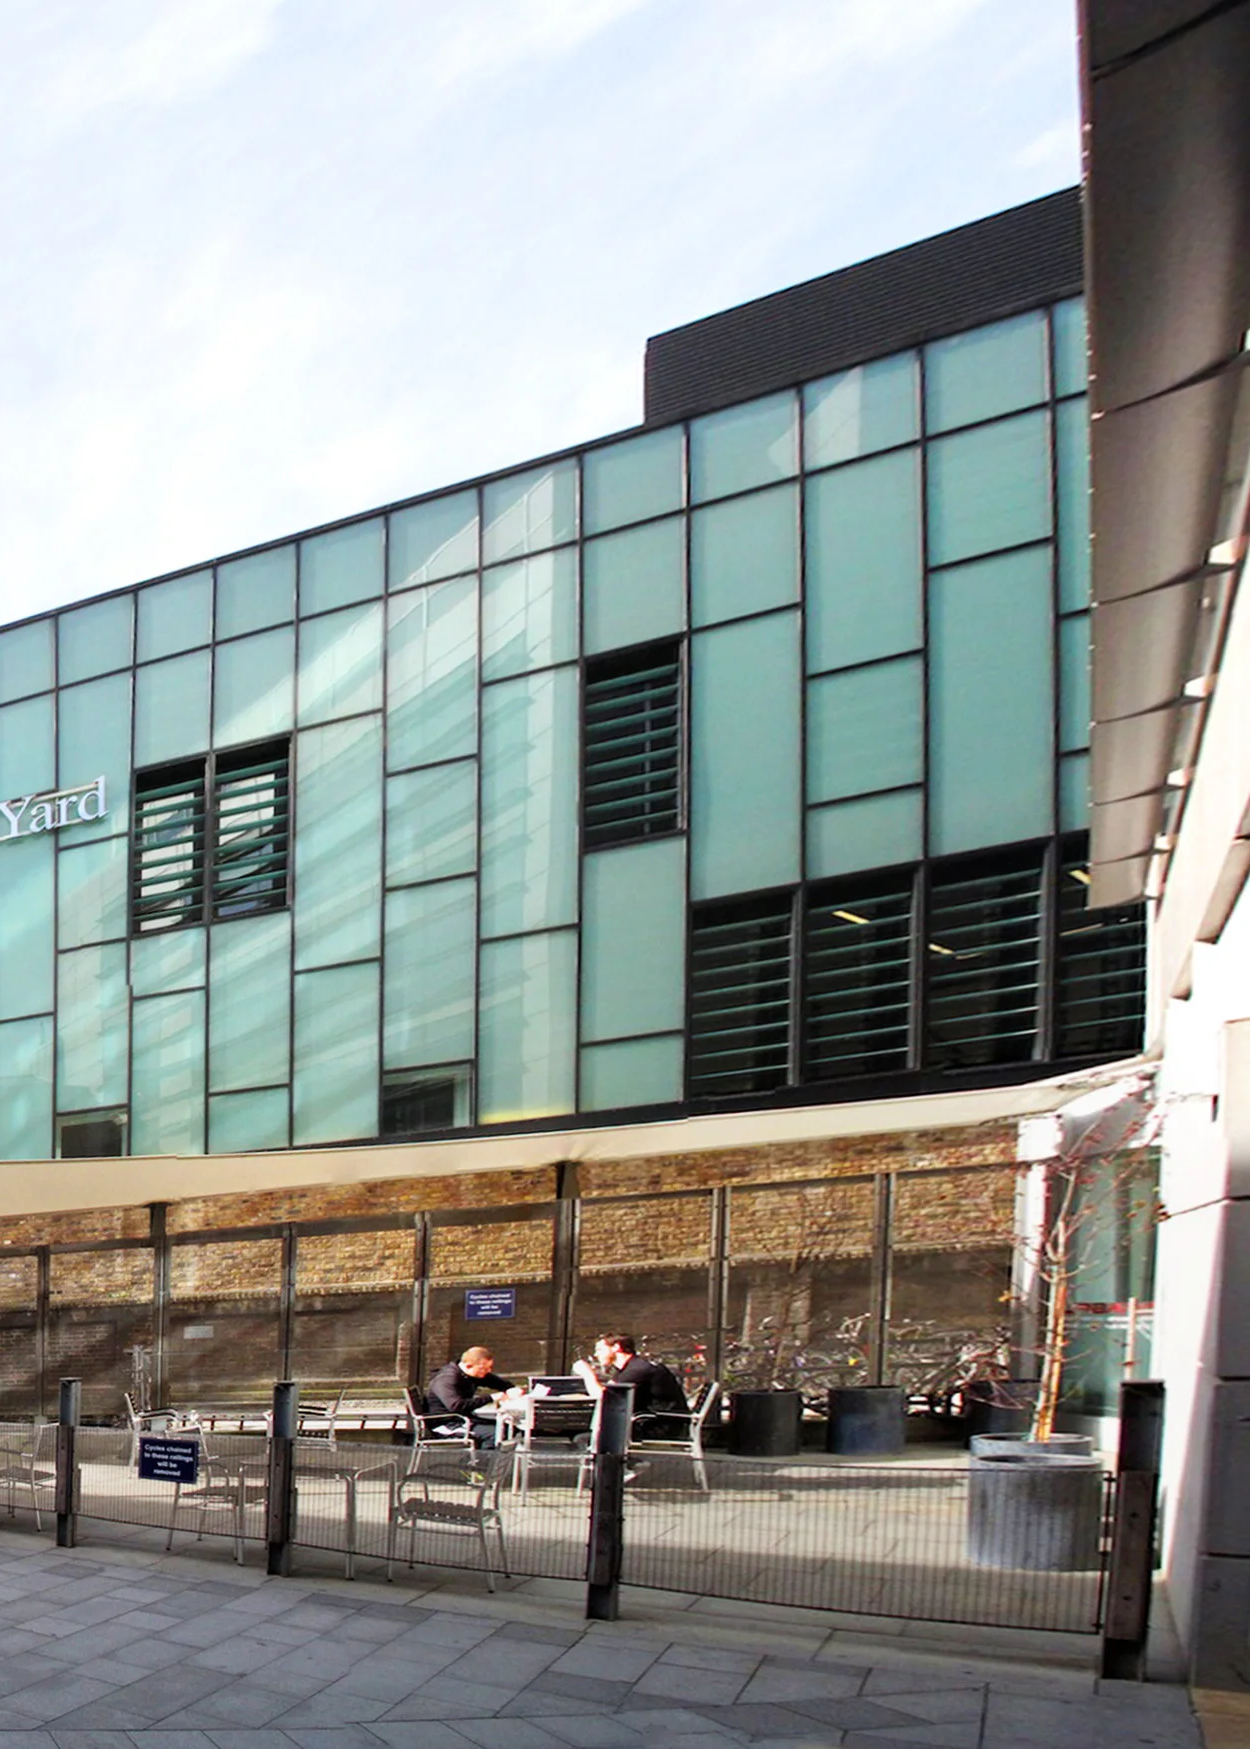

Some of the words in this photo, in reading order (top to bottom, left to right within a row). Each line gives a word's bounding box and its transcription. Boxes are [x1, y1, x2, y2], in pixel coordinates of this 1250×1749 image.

[144, 1444, 165, 1452] Cycles
[152, 1452, 169, 1460] these
[169, 1454, 194, 1463] railings
[153, 1469, 182, 1477] removed
